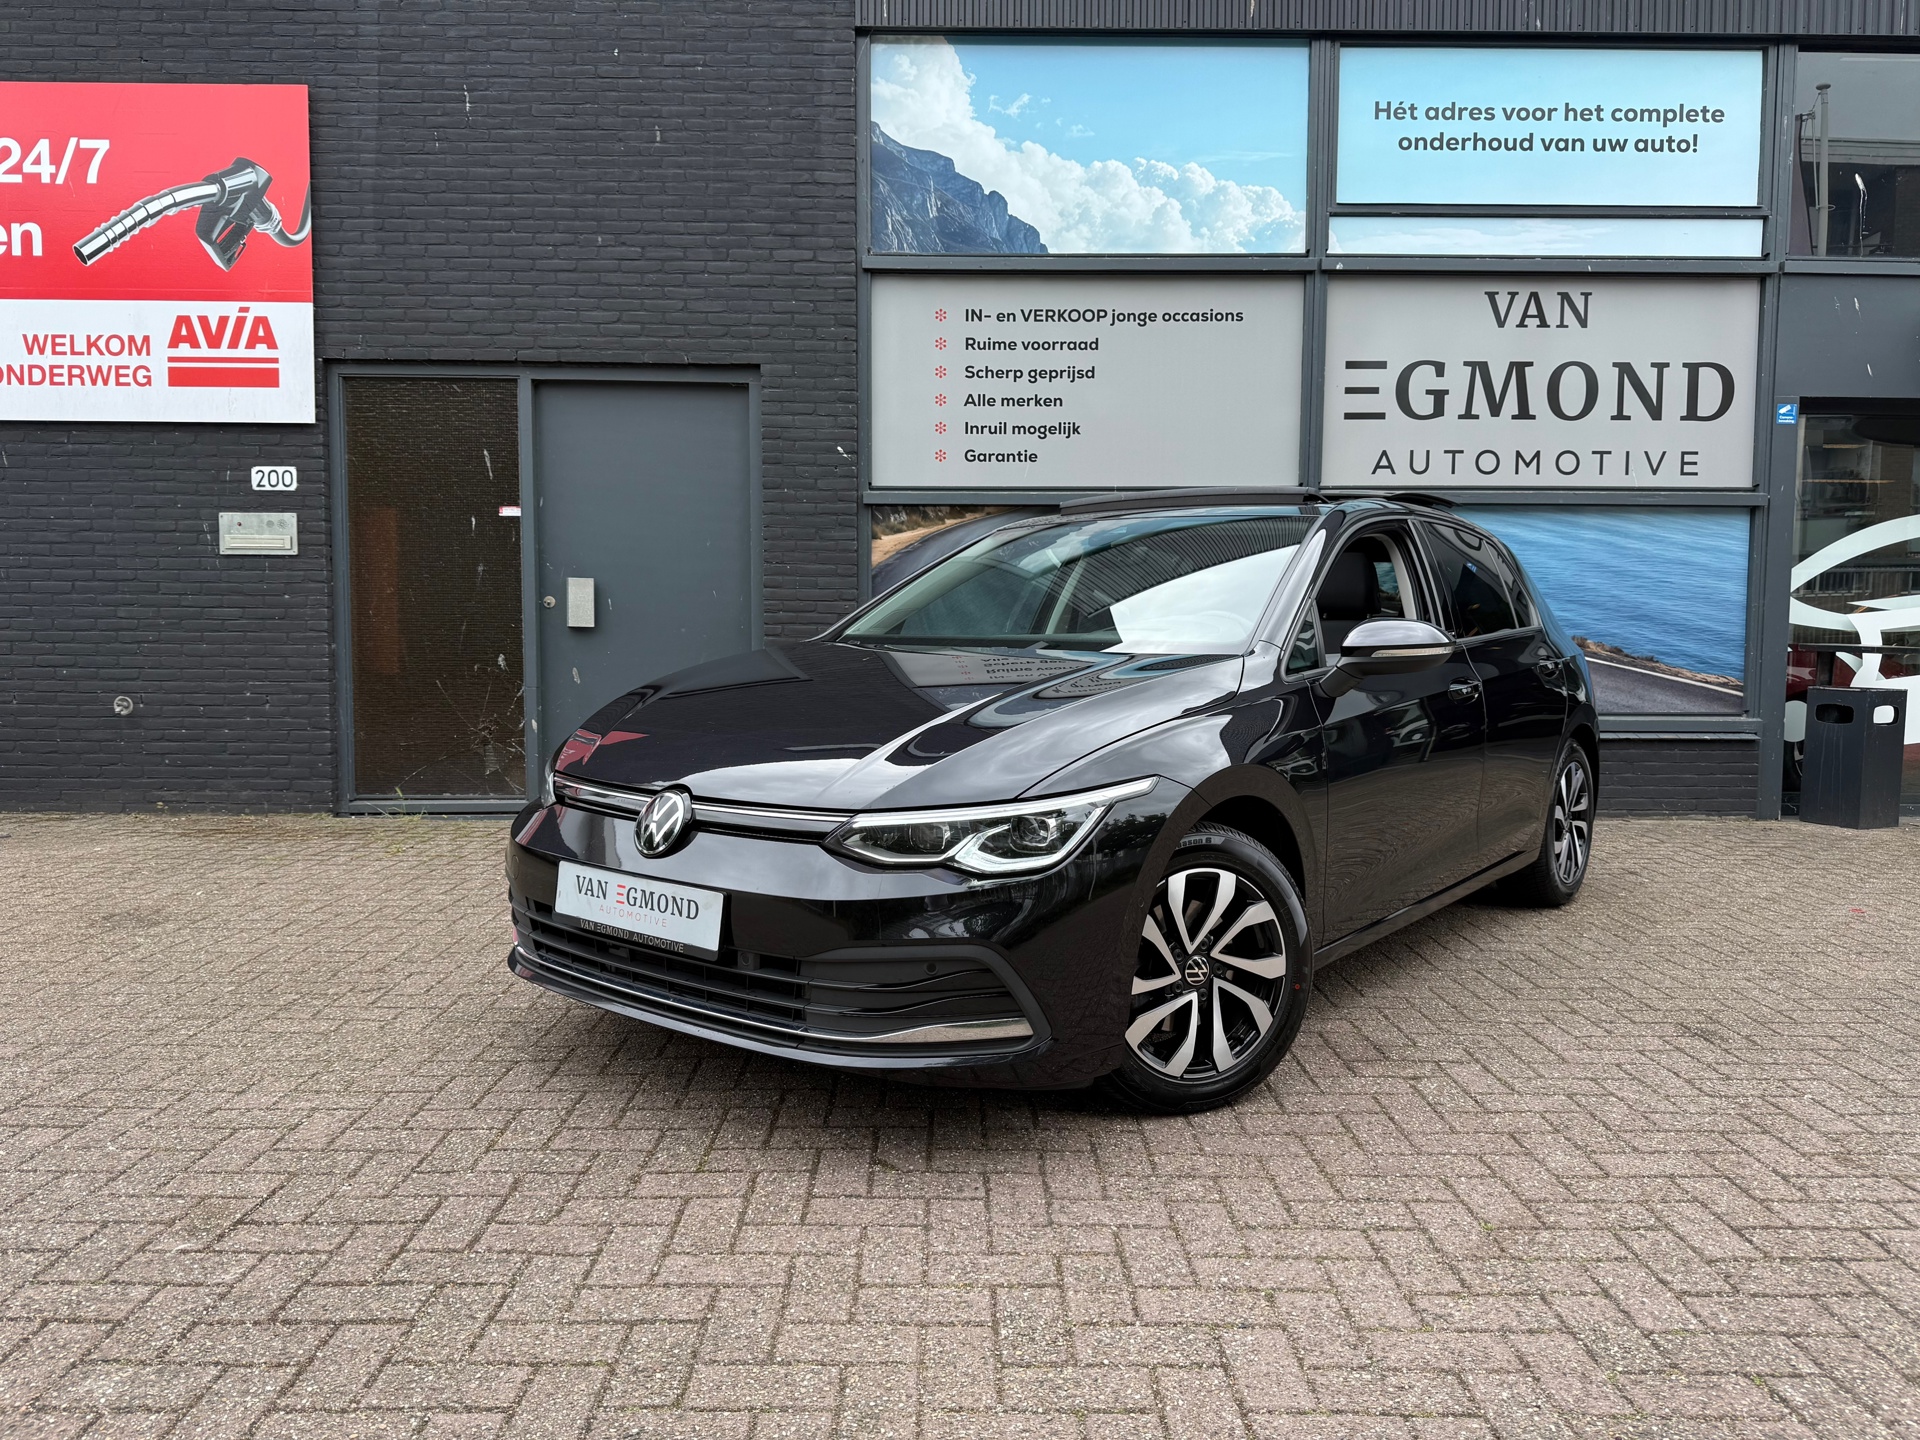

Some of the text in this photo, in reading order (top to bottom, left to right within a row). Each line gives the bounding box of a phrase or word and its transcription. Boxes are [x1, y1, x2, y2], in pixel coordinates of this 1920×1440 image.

[1374, 100, 1725, 128] Hét adres voor het complete
[1398, 131, 1698, 153] onderhoud van uw auto!
[0, 136, 110, 185] 24/7
[965, 308, 1244, 328] IN- en VERKOOP jonge occasions
[1484, 290, 1593, 329] VAN
[22, 333, 151, 357] WELKOM
[965, 337, 1099, 351] Ruime voorraad
[0, 364, 152, 387] NDERWEG
[964, 365, 1095, 383] Scherp geprijsd
[964, 393, 1063, 408] Alle merken
[1343, 359, 1735, 422] EGMOND
[964, 421, 1081, 440] Inruil mogelijk
[964, 449, 1038, 463] Garantie
[1371, 449, 1699, 476] AUTOMOTIVE
[254, 468, 294, 488] 200
[575, 874, 700, 920] VAN EGMOND
[599, 904, 668, 928] AUTOMOTIVE
[580, 919, 684, 953] VAN EGMOND AUTOMOTIVE
